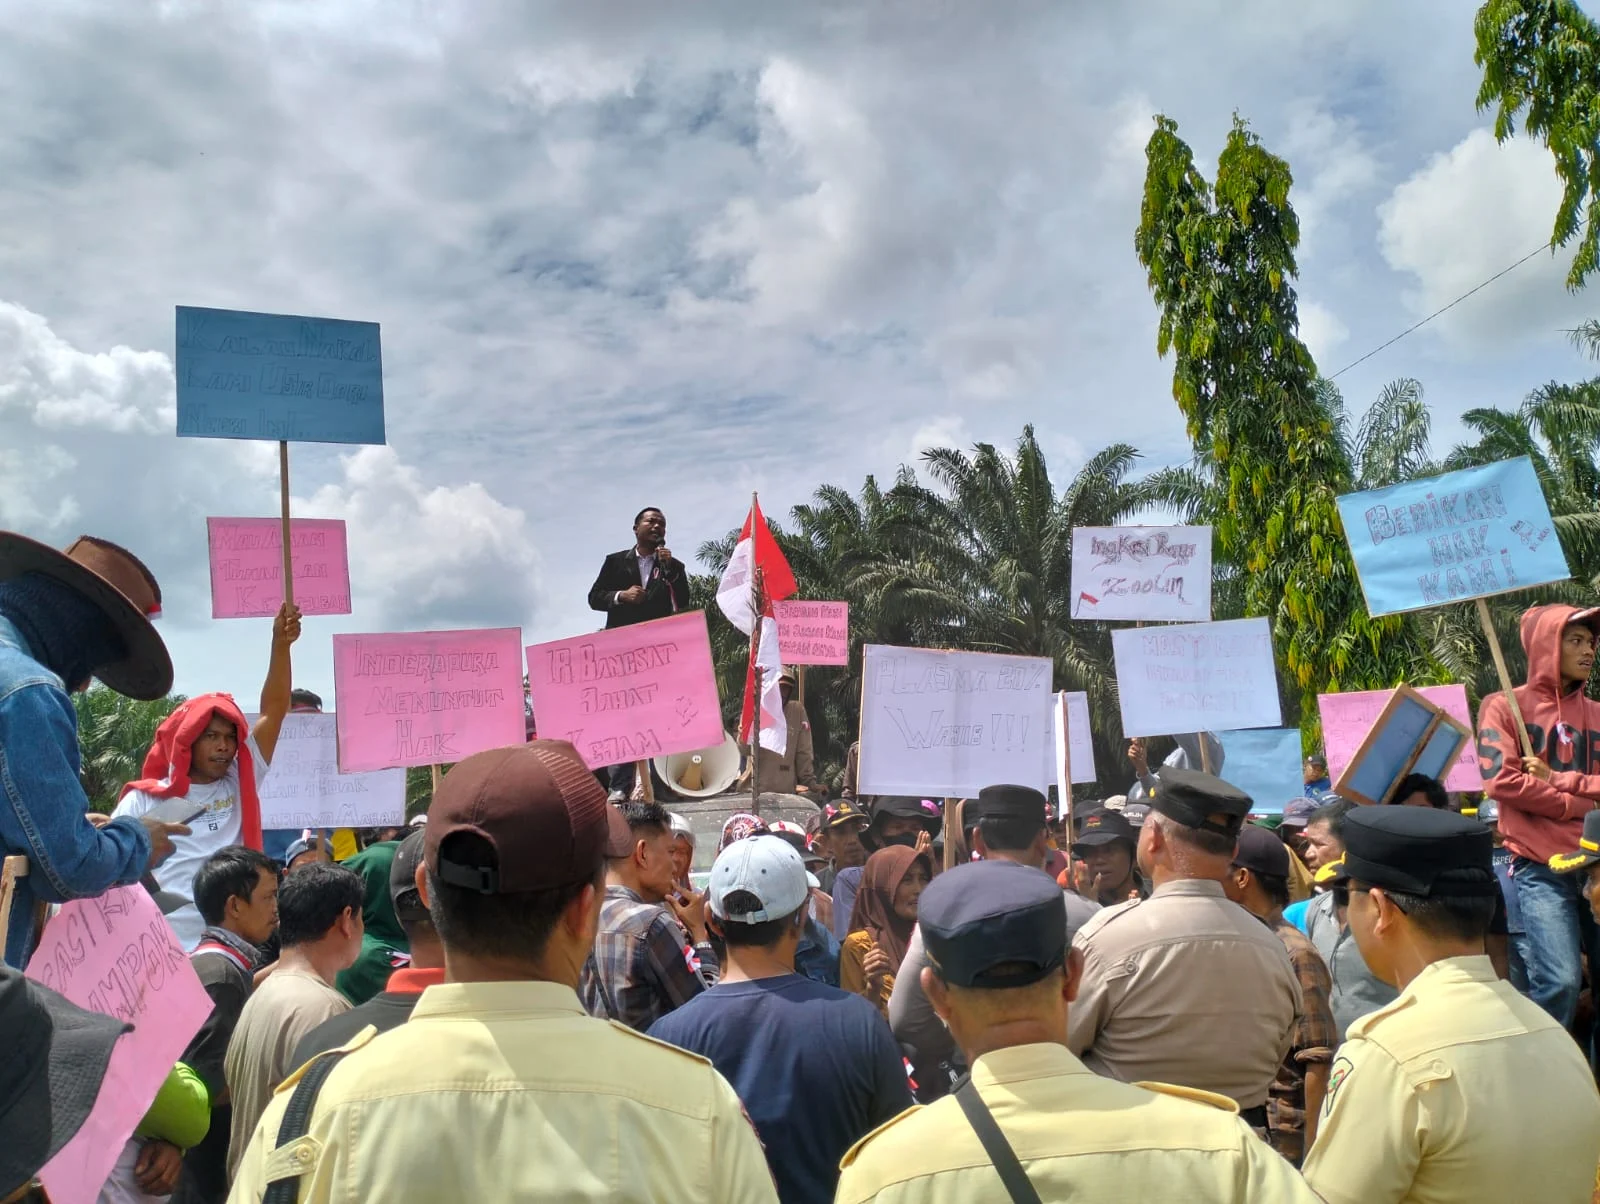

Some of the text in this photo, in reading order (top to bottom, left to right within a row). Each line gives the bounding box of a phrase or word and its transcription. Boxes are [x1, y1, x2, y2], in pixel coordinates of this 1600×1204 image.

[1427, 525, 1497, 567] HAK
[353, 639, 500, 684] INDERAPURA
[578, 642, 679, 683] BANGSAT
[873, 655, 1047, 695] PLASMA 20%
[364, 686, 504, 716] MENUNTUT
[580, 682, 658, 716] JAHAT
[389, 719, 461, 761] HAK
[883, 705, 984, 750] WAJIB
